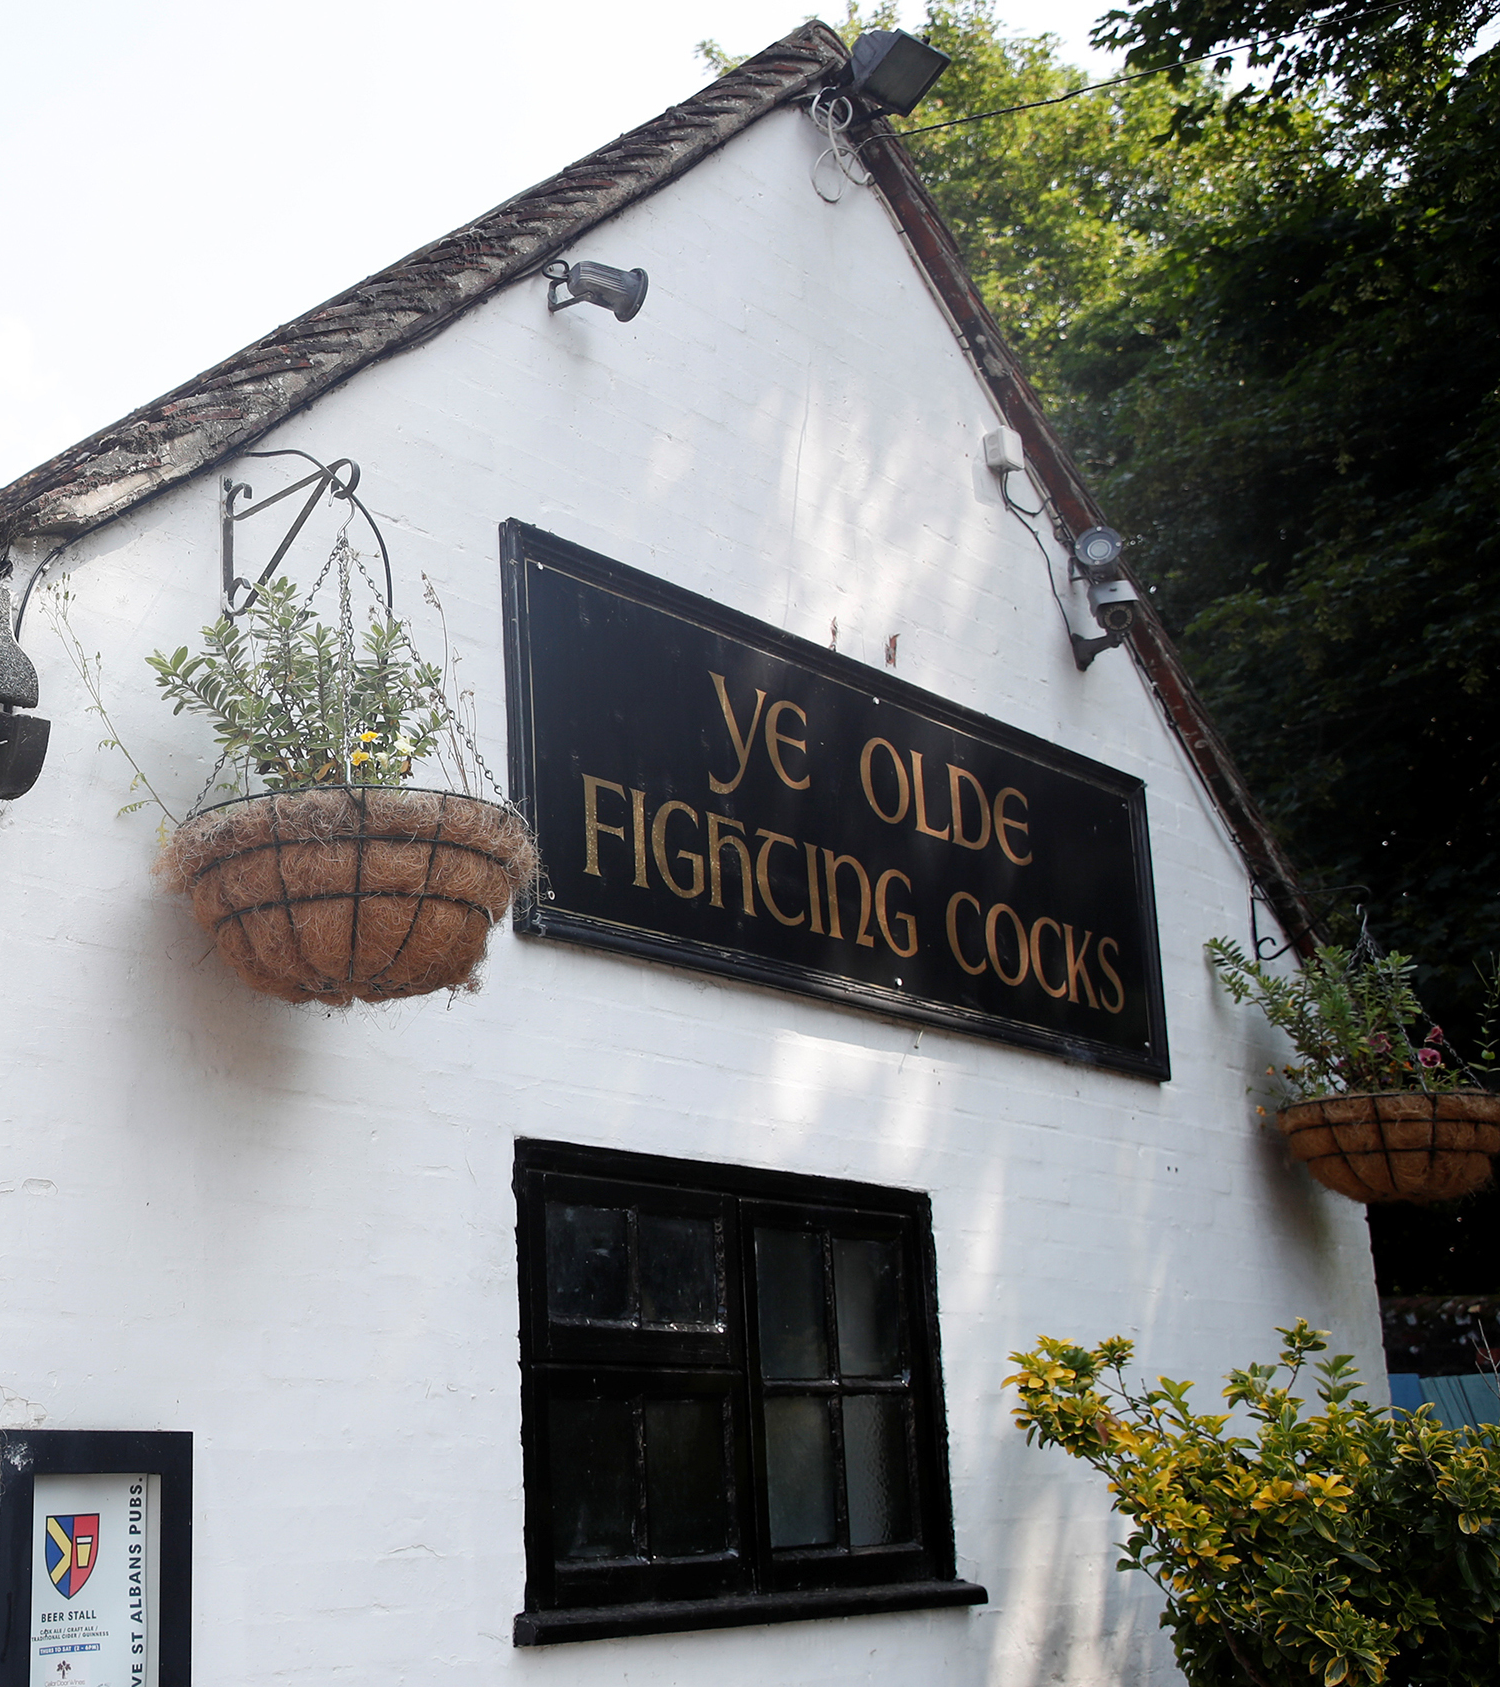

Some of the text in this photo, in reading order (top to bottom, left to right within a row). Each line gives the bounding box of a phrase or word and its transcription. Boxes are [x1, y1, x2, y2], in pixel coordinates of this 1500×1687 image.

[860, 736, 1033, 867] OLDE
[581, 773, 1125, 1015] FIGHTING COCKS
[129, 1477, 143, 1534] PUBS.
[41, 1610, 96, 1622] BEER STALL
[129, 1544, 143, 1623] ALBANS
[132, 1632, 143, 1654] ST
